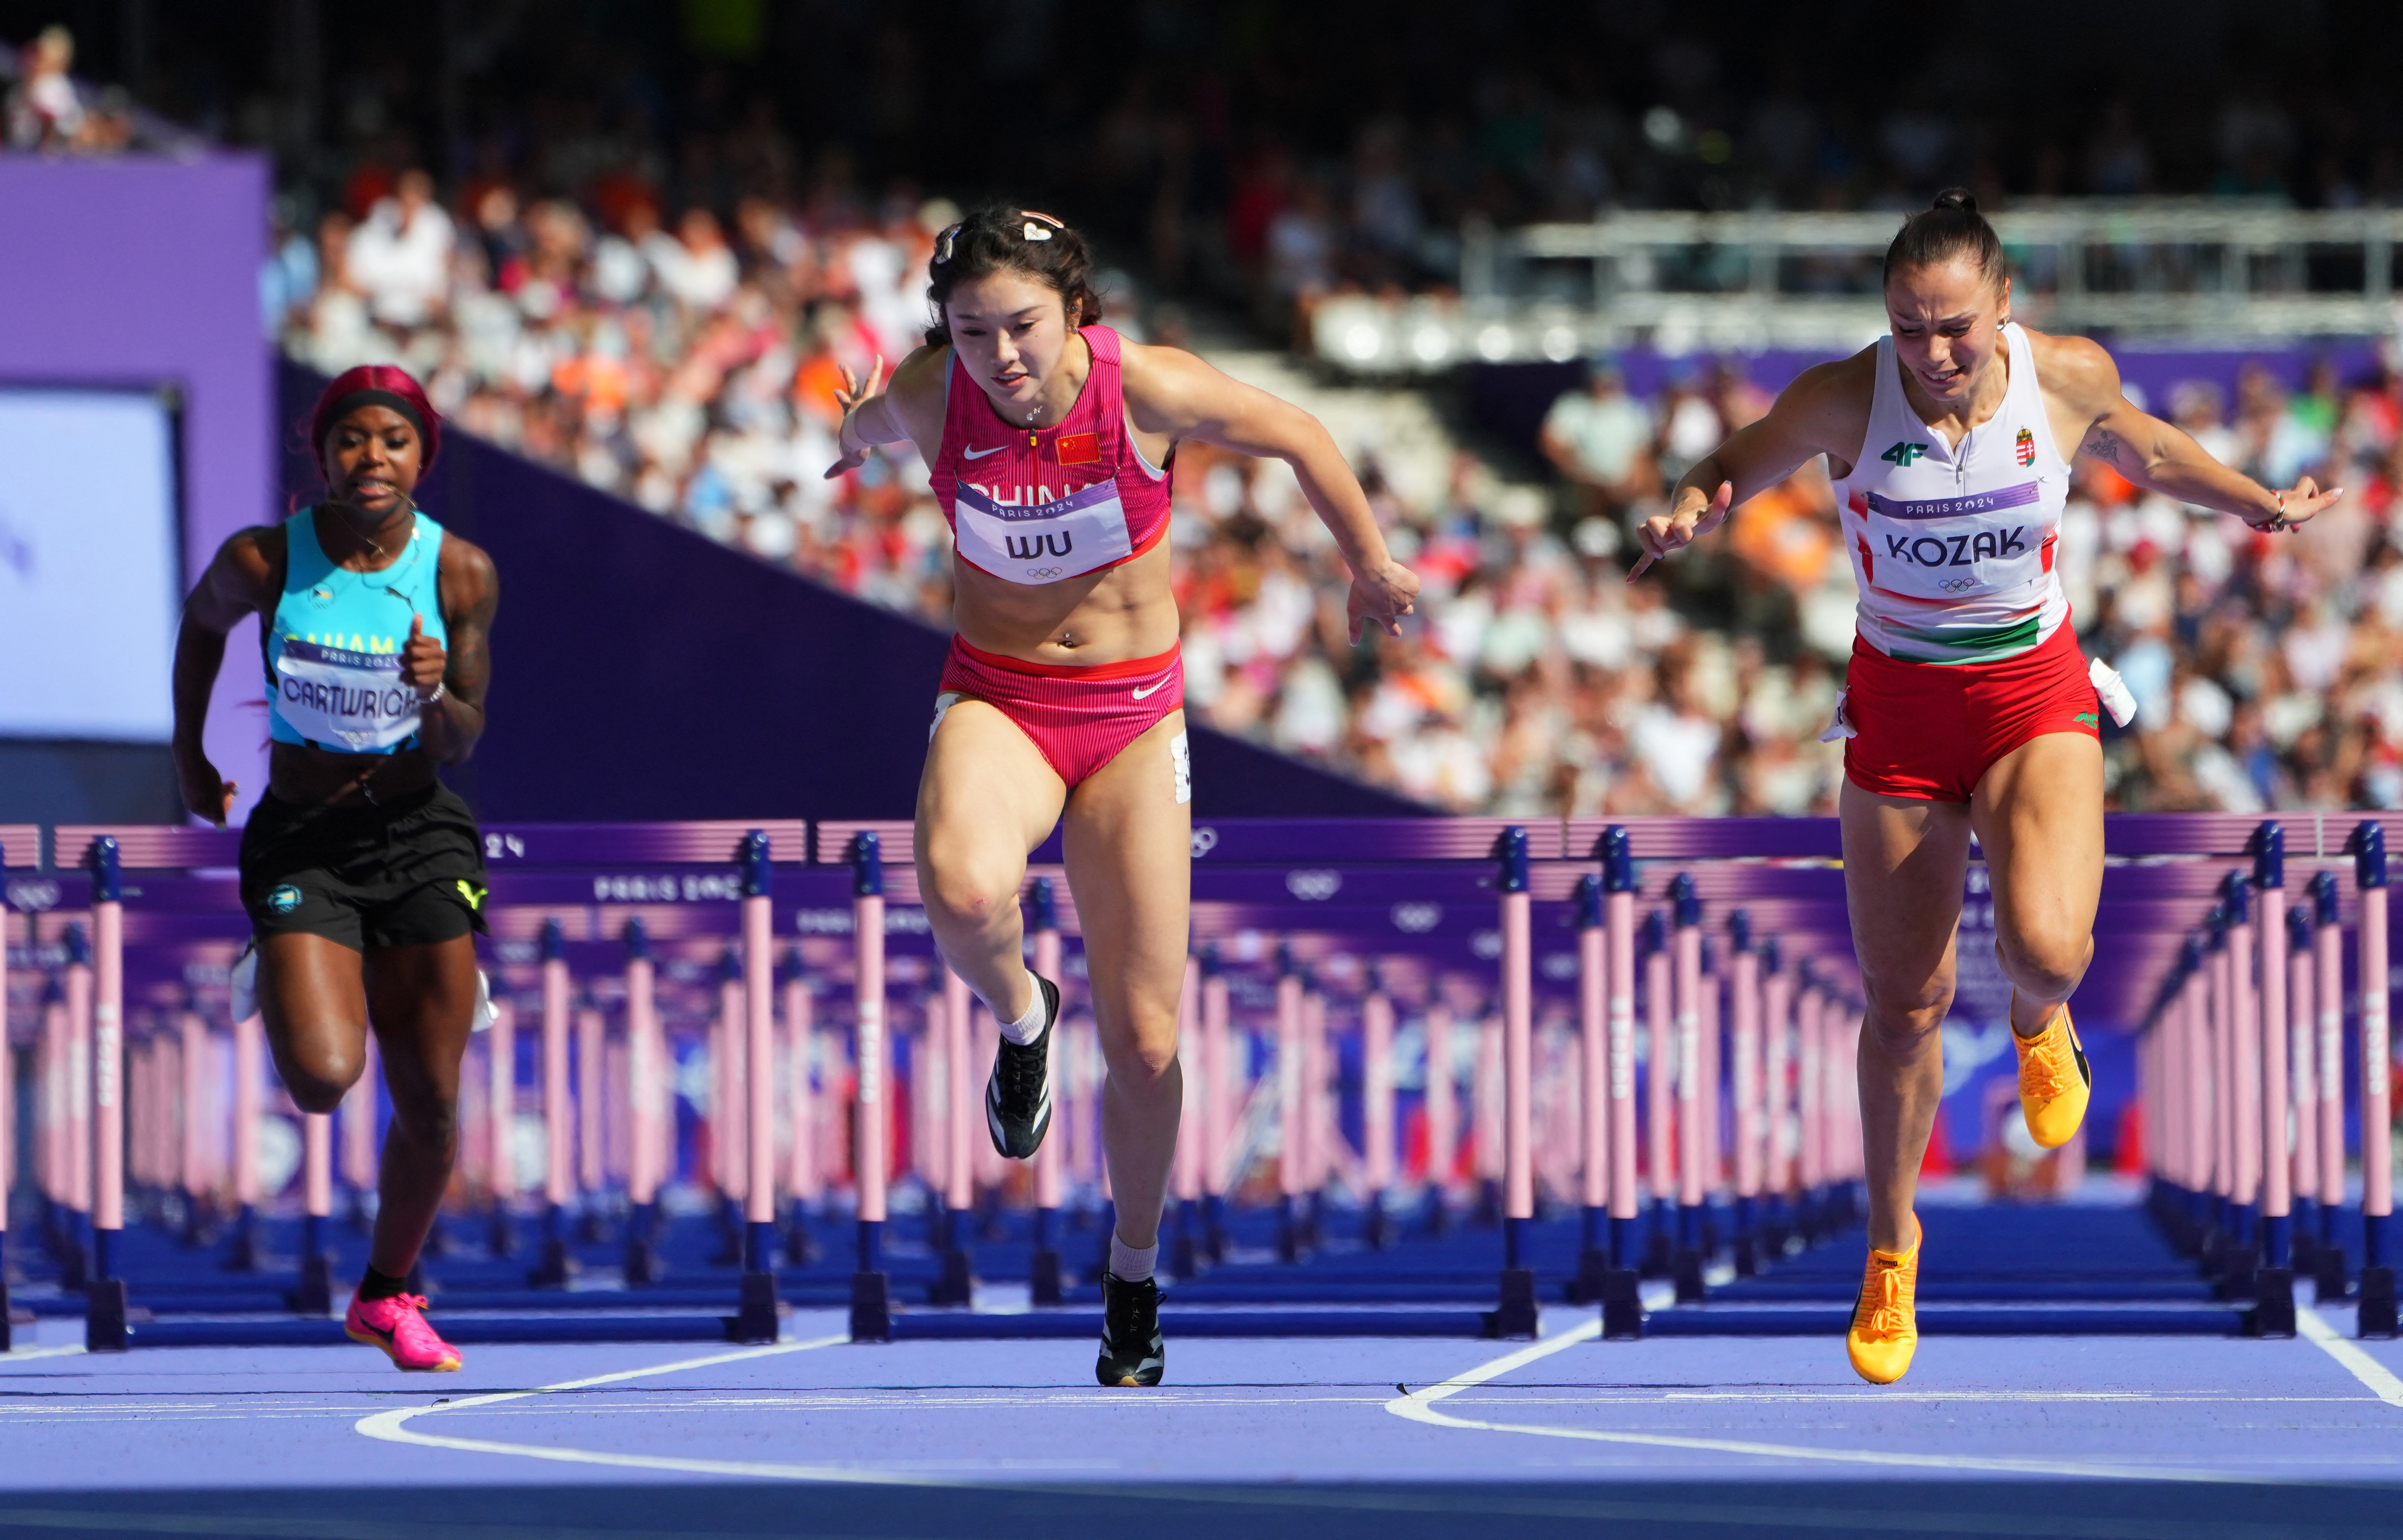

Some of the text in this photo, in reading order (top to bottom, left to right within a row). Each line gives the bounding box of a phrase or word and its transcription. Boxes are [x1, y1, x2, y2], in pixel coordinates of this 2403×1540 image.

[1881, 441, 1928, 468] 4F
[992, 501, 1073, 517] PARIS 2024
[1907, 497, 1994, 515] PARIS 2024
[1005, 531, 1072, 560] WU
[1885, 526, 2025, 567] KOZAK
